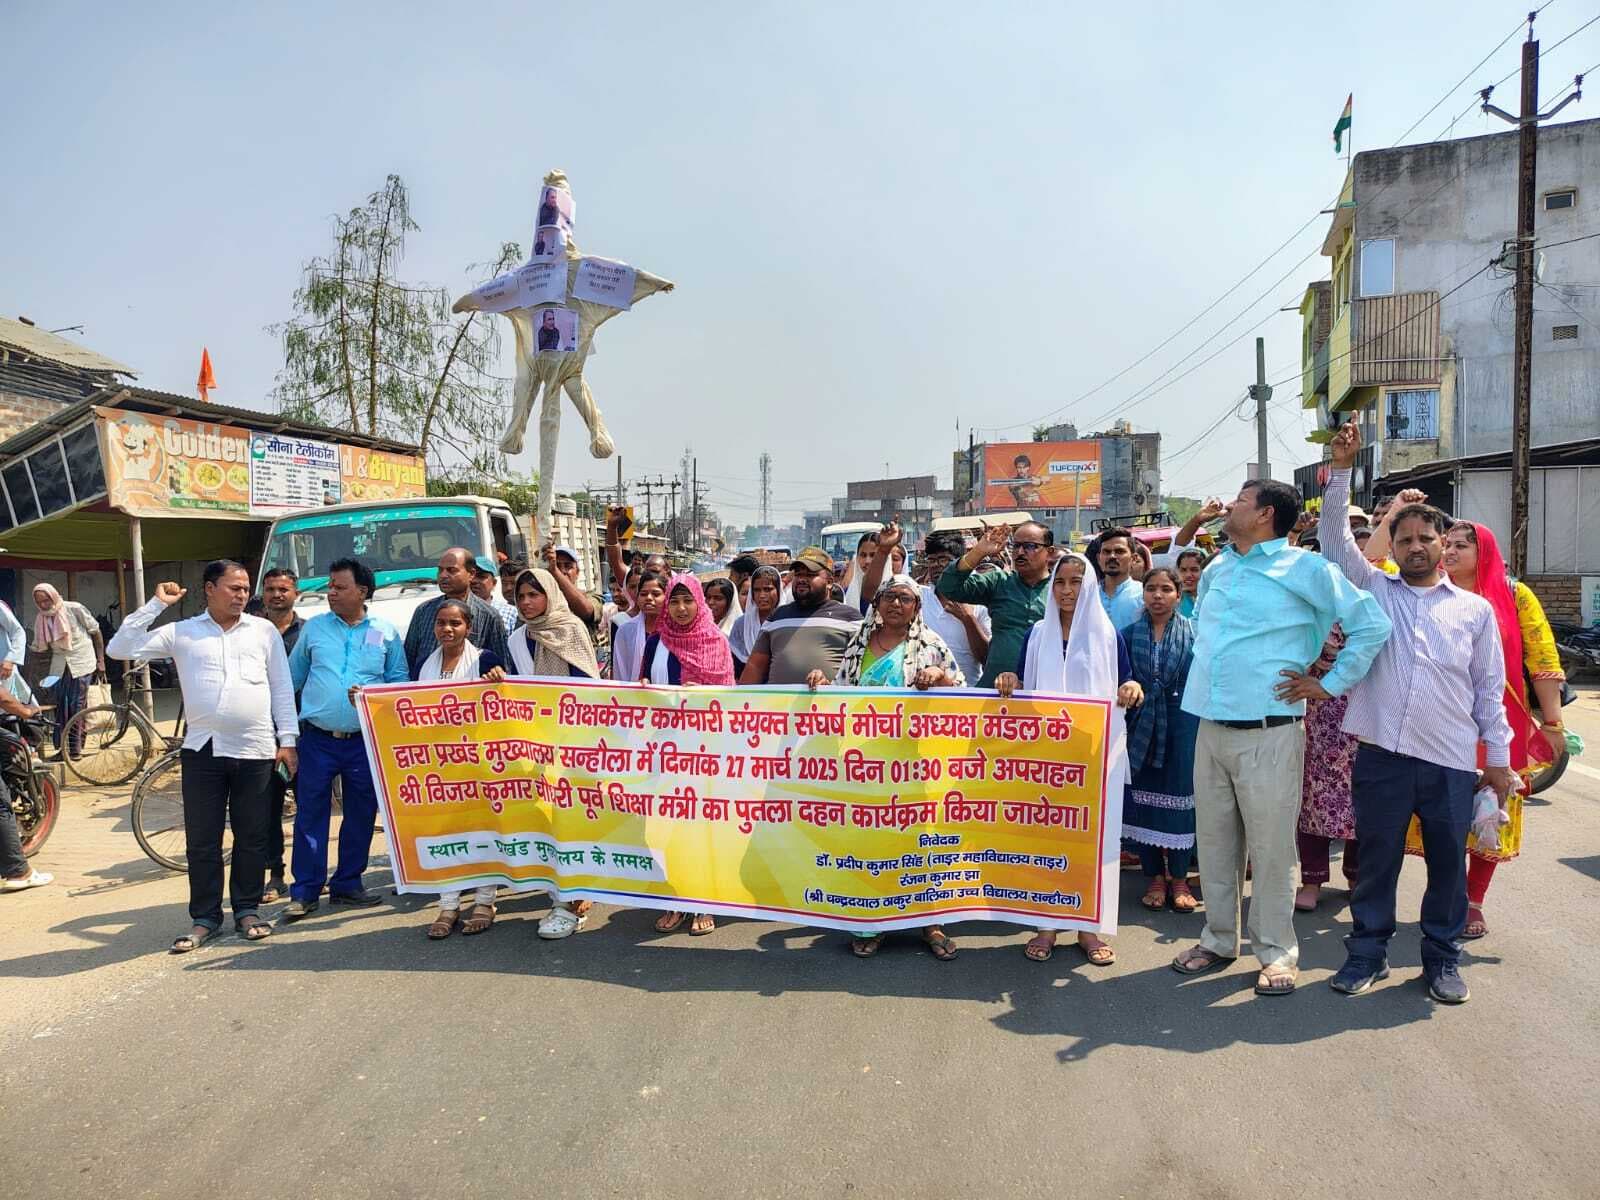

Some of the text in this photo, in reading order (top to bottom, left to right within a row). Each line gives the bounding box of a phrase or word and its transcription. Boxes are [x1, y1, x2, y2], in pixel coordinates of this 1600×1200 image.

[267, 438, 293, 455] सोना
[358, 454, 368, 479] &
[368, 453, 424, 489] Biryani
[1050, 462, 1097, 471] TUFCONXT
[396, 694, 477, 726] वित्तरहित
[481, 690, 536, 721] शिक्षक
[558, 693, 648, 729] शिक्षकेत्तर
[651, 700, 723, 732] कर्मचारी
[728, 702, 789, 748] संयुक्त
[794, 703, 847, 737] संघर्ष
[852, 704, 903, 738] मोर्चा
[909, 714, 977, 739] अध्यक्ष
[983, 707, 1042, 740] मंडल
[1046, 709, 1072, 740] के
[393, 735, 1087, 788] द्वारा प्रखंड मुख्यालय सन्हौला में दिनांक 27 मार्च 2025 दिन 01:30 बजे अपराहन
[400, 775, 421, 804] श्री
[426, 774, 478, 804] विजय
[481, 778, 533, 814] कुमार
[578, 782, 604, 819] पूर्व
[608, 782, 654, 817] शिक्षा
[659, 786, 698, 820] मंत्री
[702, 797, 729, 821] का
[735, 800, 792, 833] पुतला
[798, 800, 847, 827] दहन
[851, 794, 938, 831] कार्यक्रम
[944, 791, 998, 823] किया
[1002, 796, 1089, 831] जायेगा।
[919, 833, 960, 848] निवेदक
[427, 839, 469, 860] स्थान
[591, 846, 606, 866] के
[612, 851, 653, 871] समक्ष
[816, 853, 832, 867] डॉ.
[836, 855, 863, 869] प्रदीप
[866, 859, 899, 876] कुमार
[901, 854, 923, 868] सिंह
[962, 849, 1030, 865] महाविद्यालय
[900, 870, 981, 887] रंजन कुमार झा
[804, 888, 823, 904] (श्री
[827, 894, 879, 909] चन्द्रदयाल
[883, 893, 912, 909] ठाकुर
[957, 888, 979, 898] उच्च
[983, 885, 1028, 900] विद्यालय
